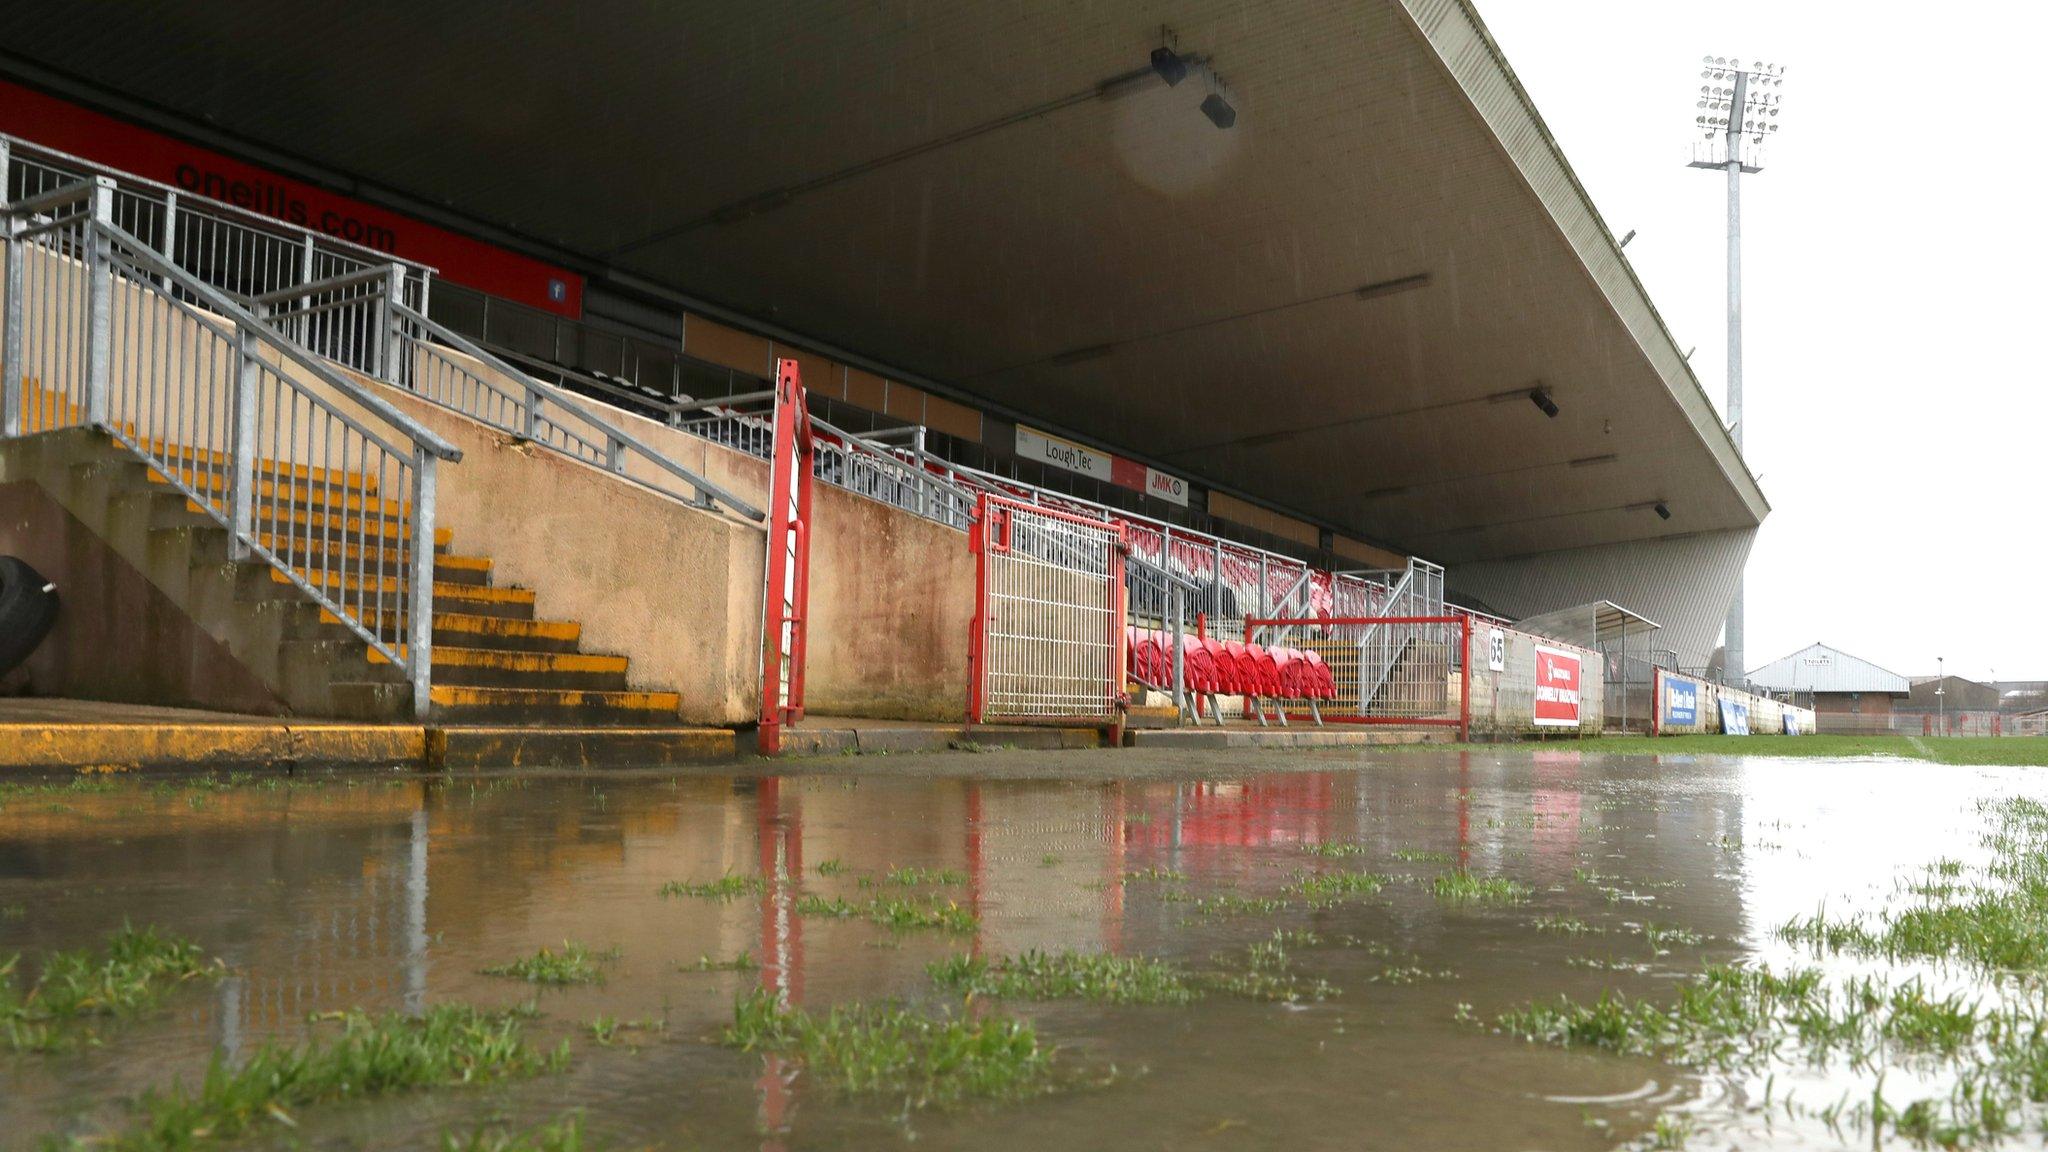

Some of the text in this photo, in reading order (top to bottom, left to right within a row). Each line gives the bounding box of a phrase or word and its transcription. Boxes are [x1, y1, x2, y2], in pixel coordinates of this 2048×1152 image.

[176, 164, 397, 252] oneills.com
[1152, 473, 1172, 494] JMK
[1490, 636, 1503, 664] 65
